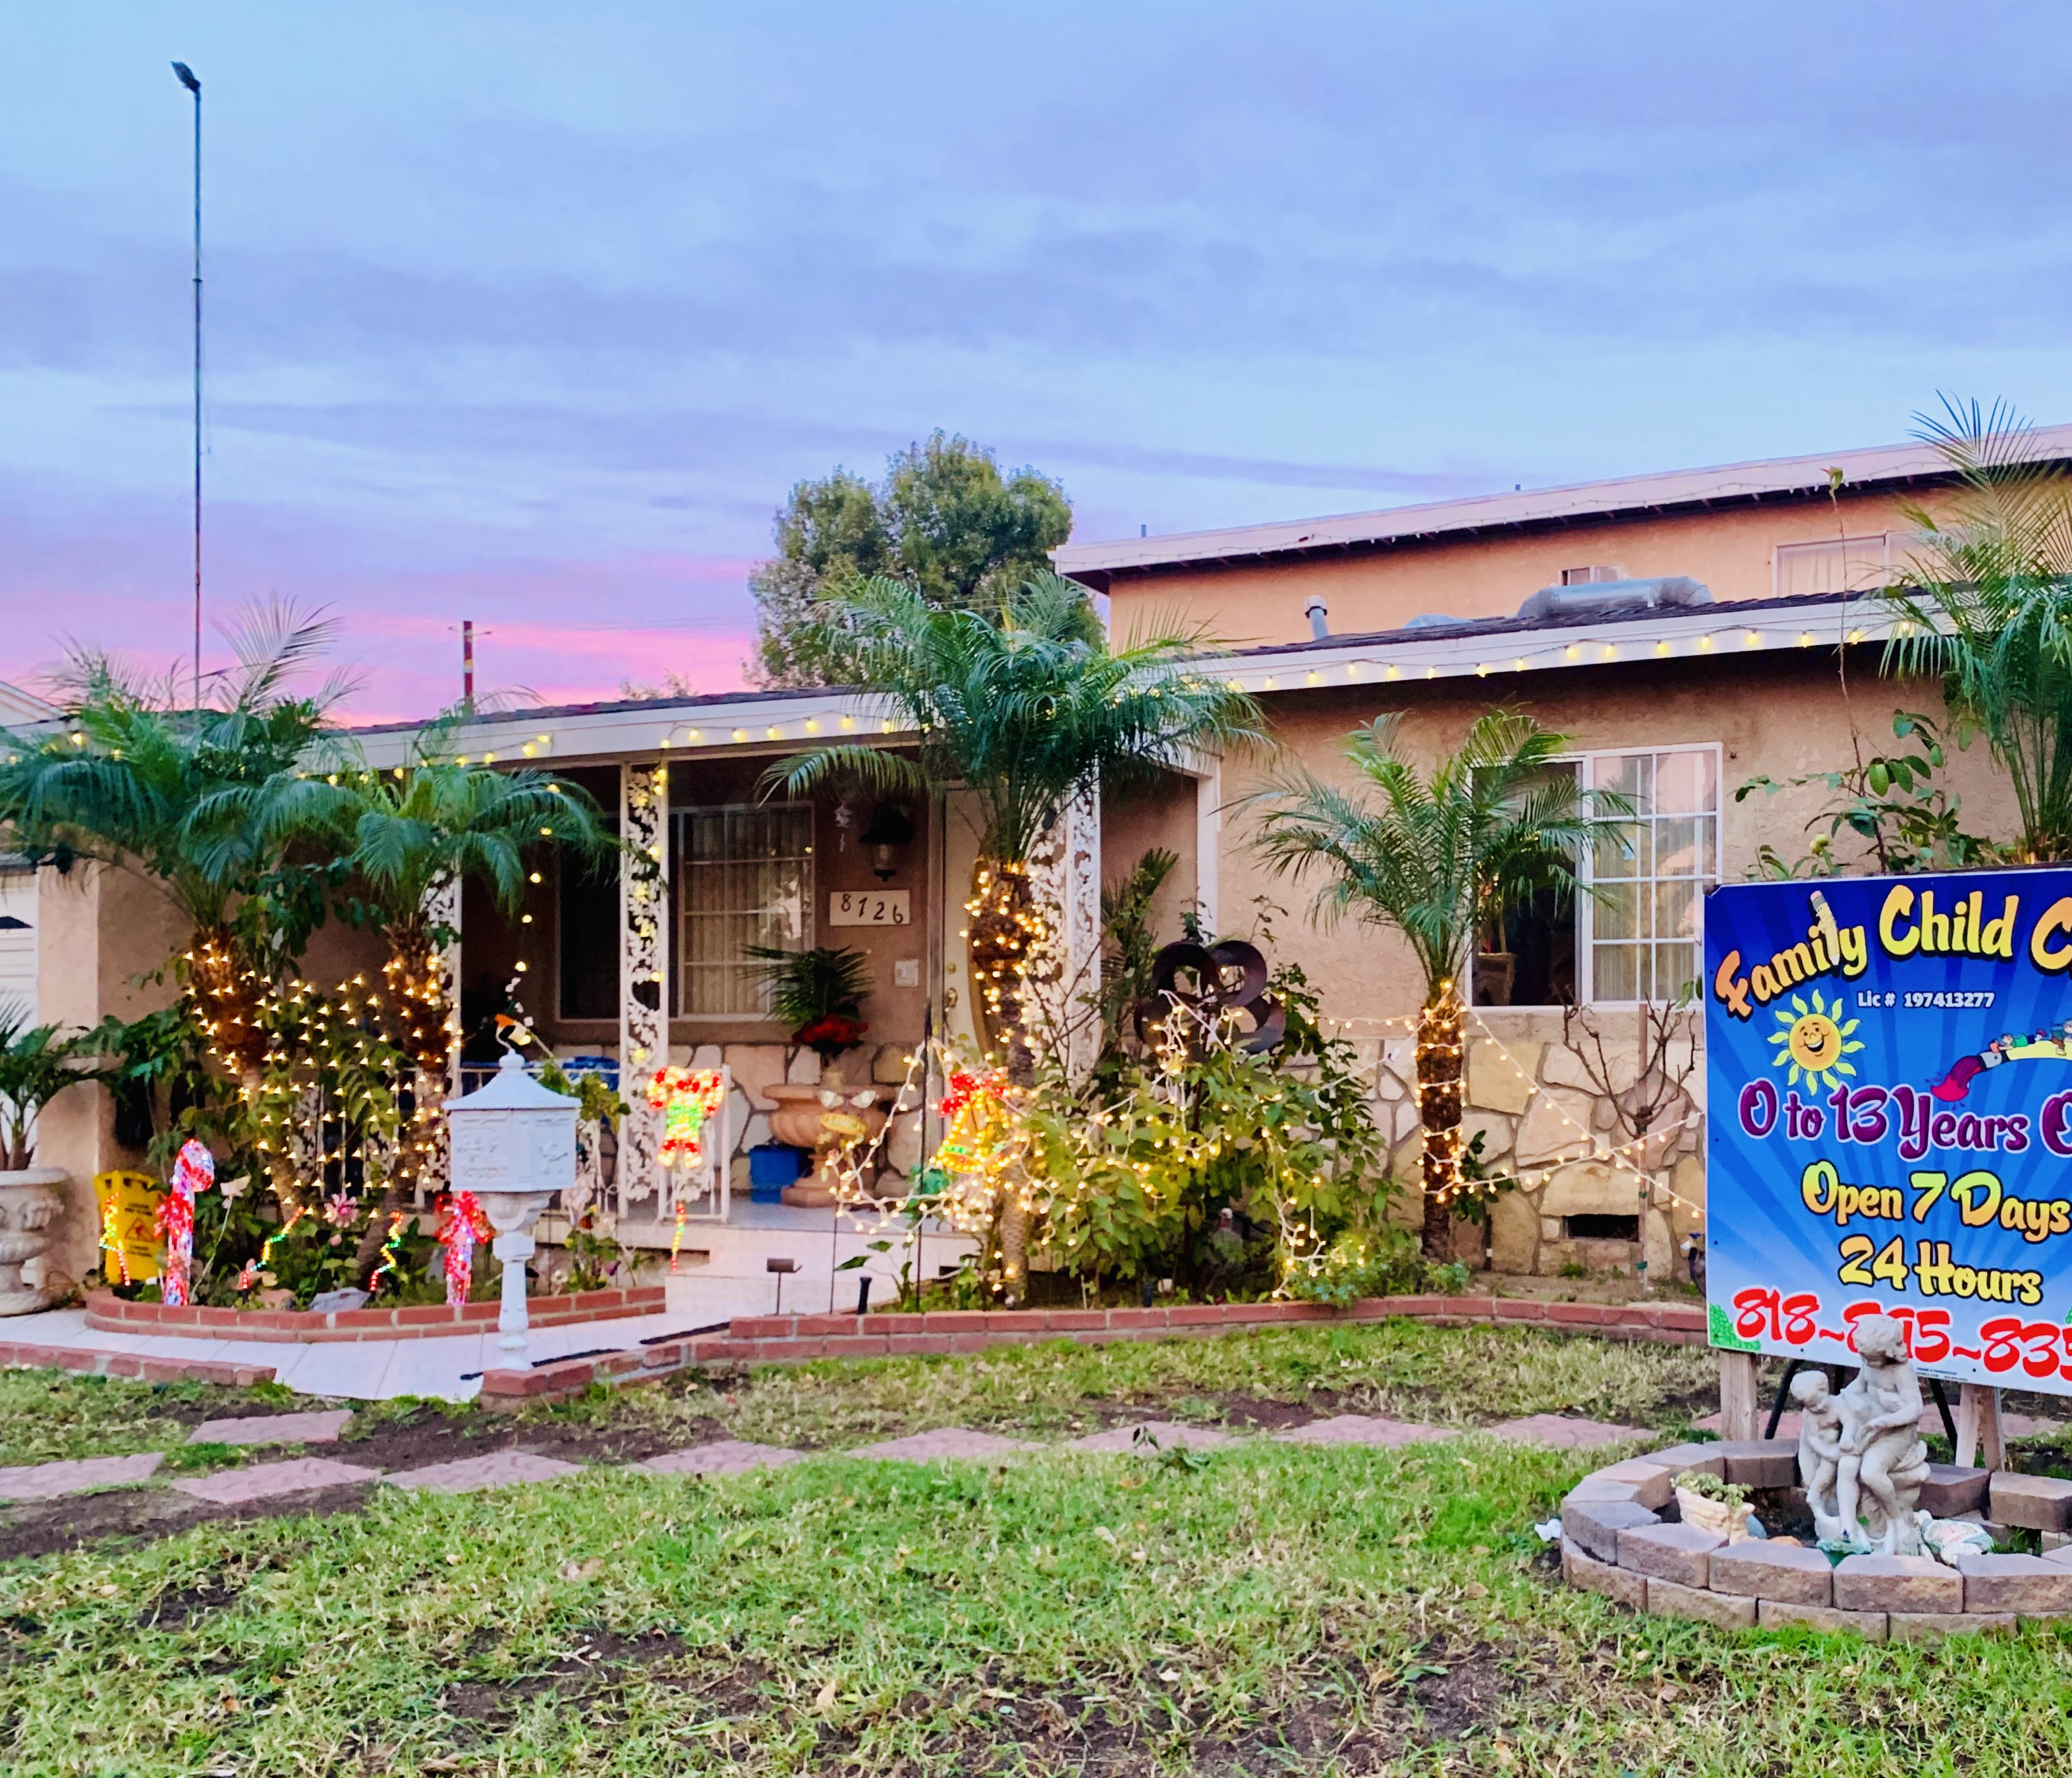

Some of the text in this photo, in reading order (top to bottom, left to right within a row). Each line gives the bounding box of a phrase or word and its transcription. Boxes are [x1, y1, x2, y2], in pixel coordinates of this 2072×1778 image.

[1716, 890, 1867, 1018] Family
[1879, 884, 2019, 958] Child
[1858, 990, 1995, 1008] Lic # 197413277
[1784, 1092, 1826, 1139] to
[1828, 1083, 1889, 1144] 13
[1891, 1085, 2030, 1161] Years
[1802, 1161, 2072, 1242] Open 7 Days
[1838, 1234, 2043, 1305] 24 Hours
